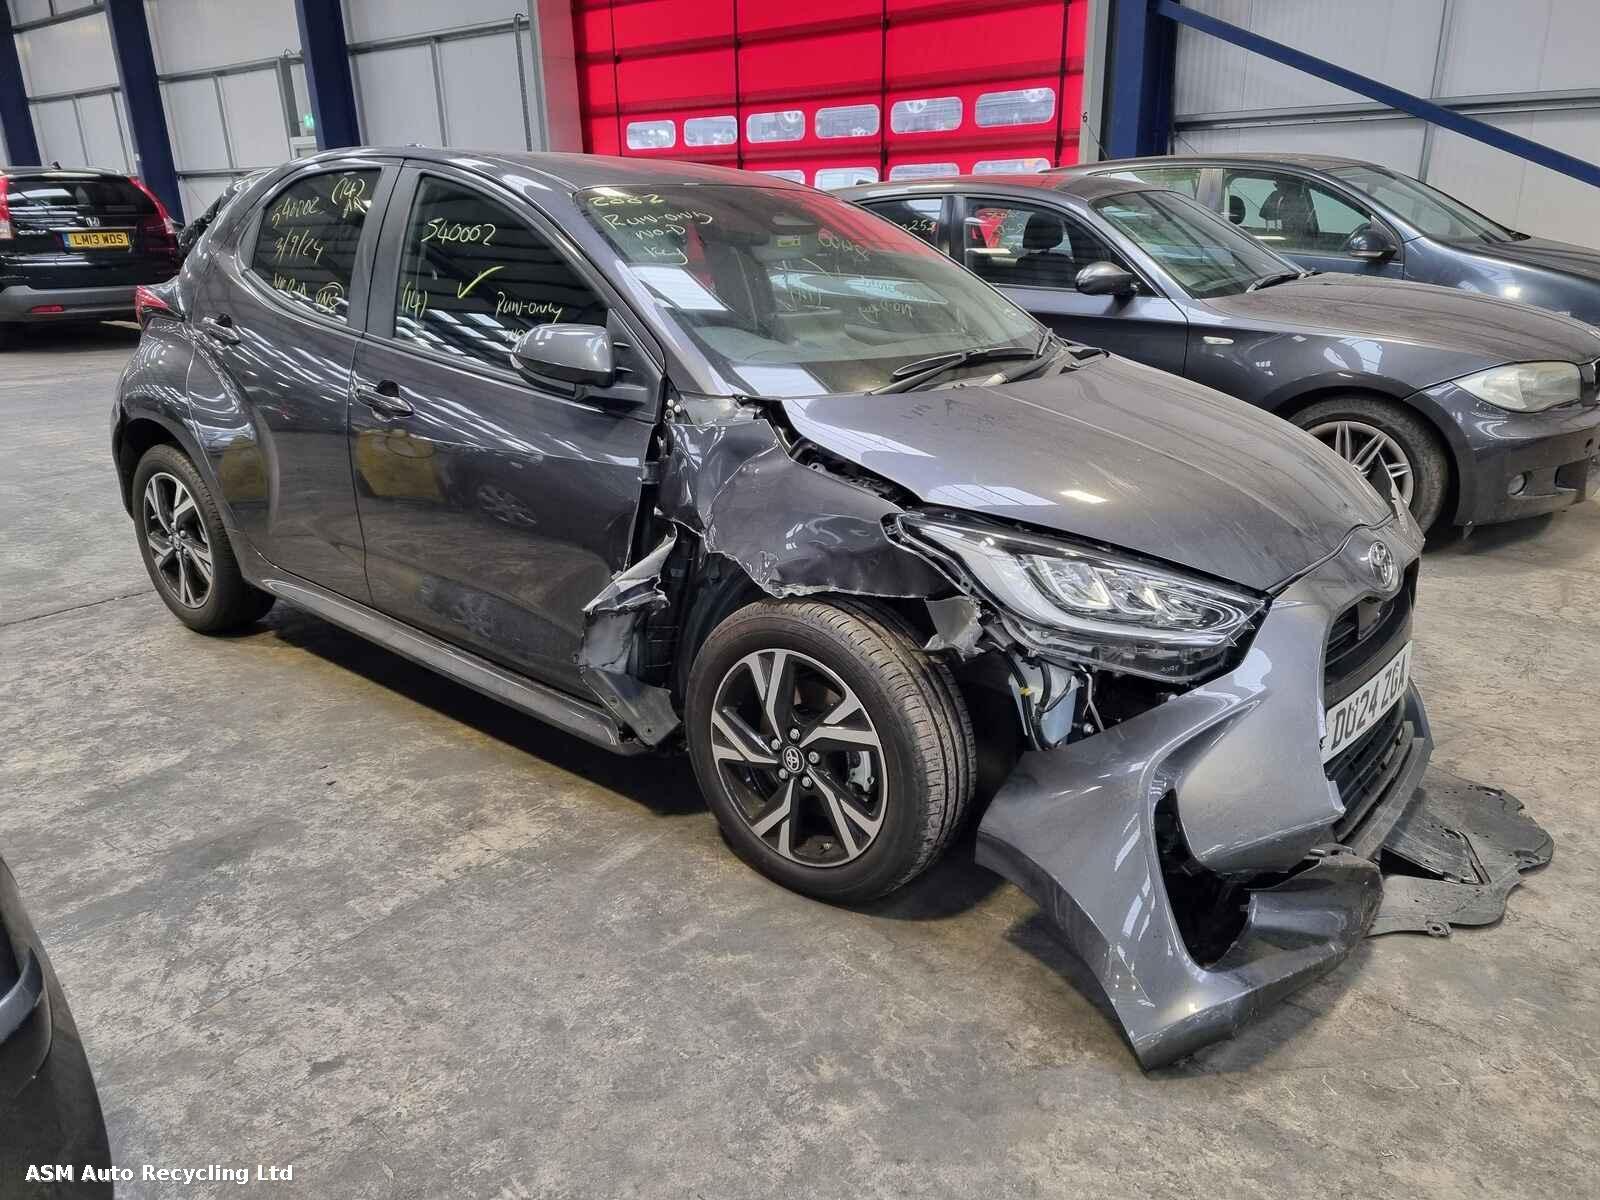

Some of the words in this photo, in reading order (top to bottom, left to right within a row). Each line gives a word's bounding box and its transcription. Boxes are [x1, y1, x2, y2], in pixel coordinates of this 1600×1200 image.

[75, 234, 100, 246] LM13
[102, 233, 124, 245] WDS
[401, 281, 429, 319] (14)
[1331, 680, 1380, 751] DU24
[1380, 653, 1407, 709] ZGA
